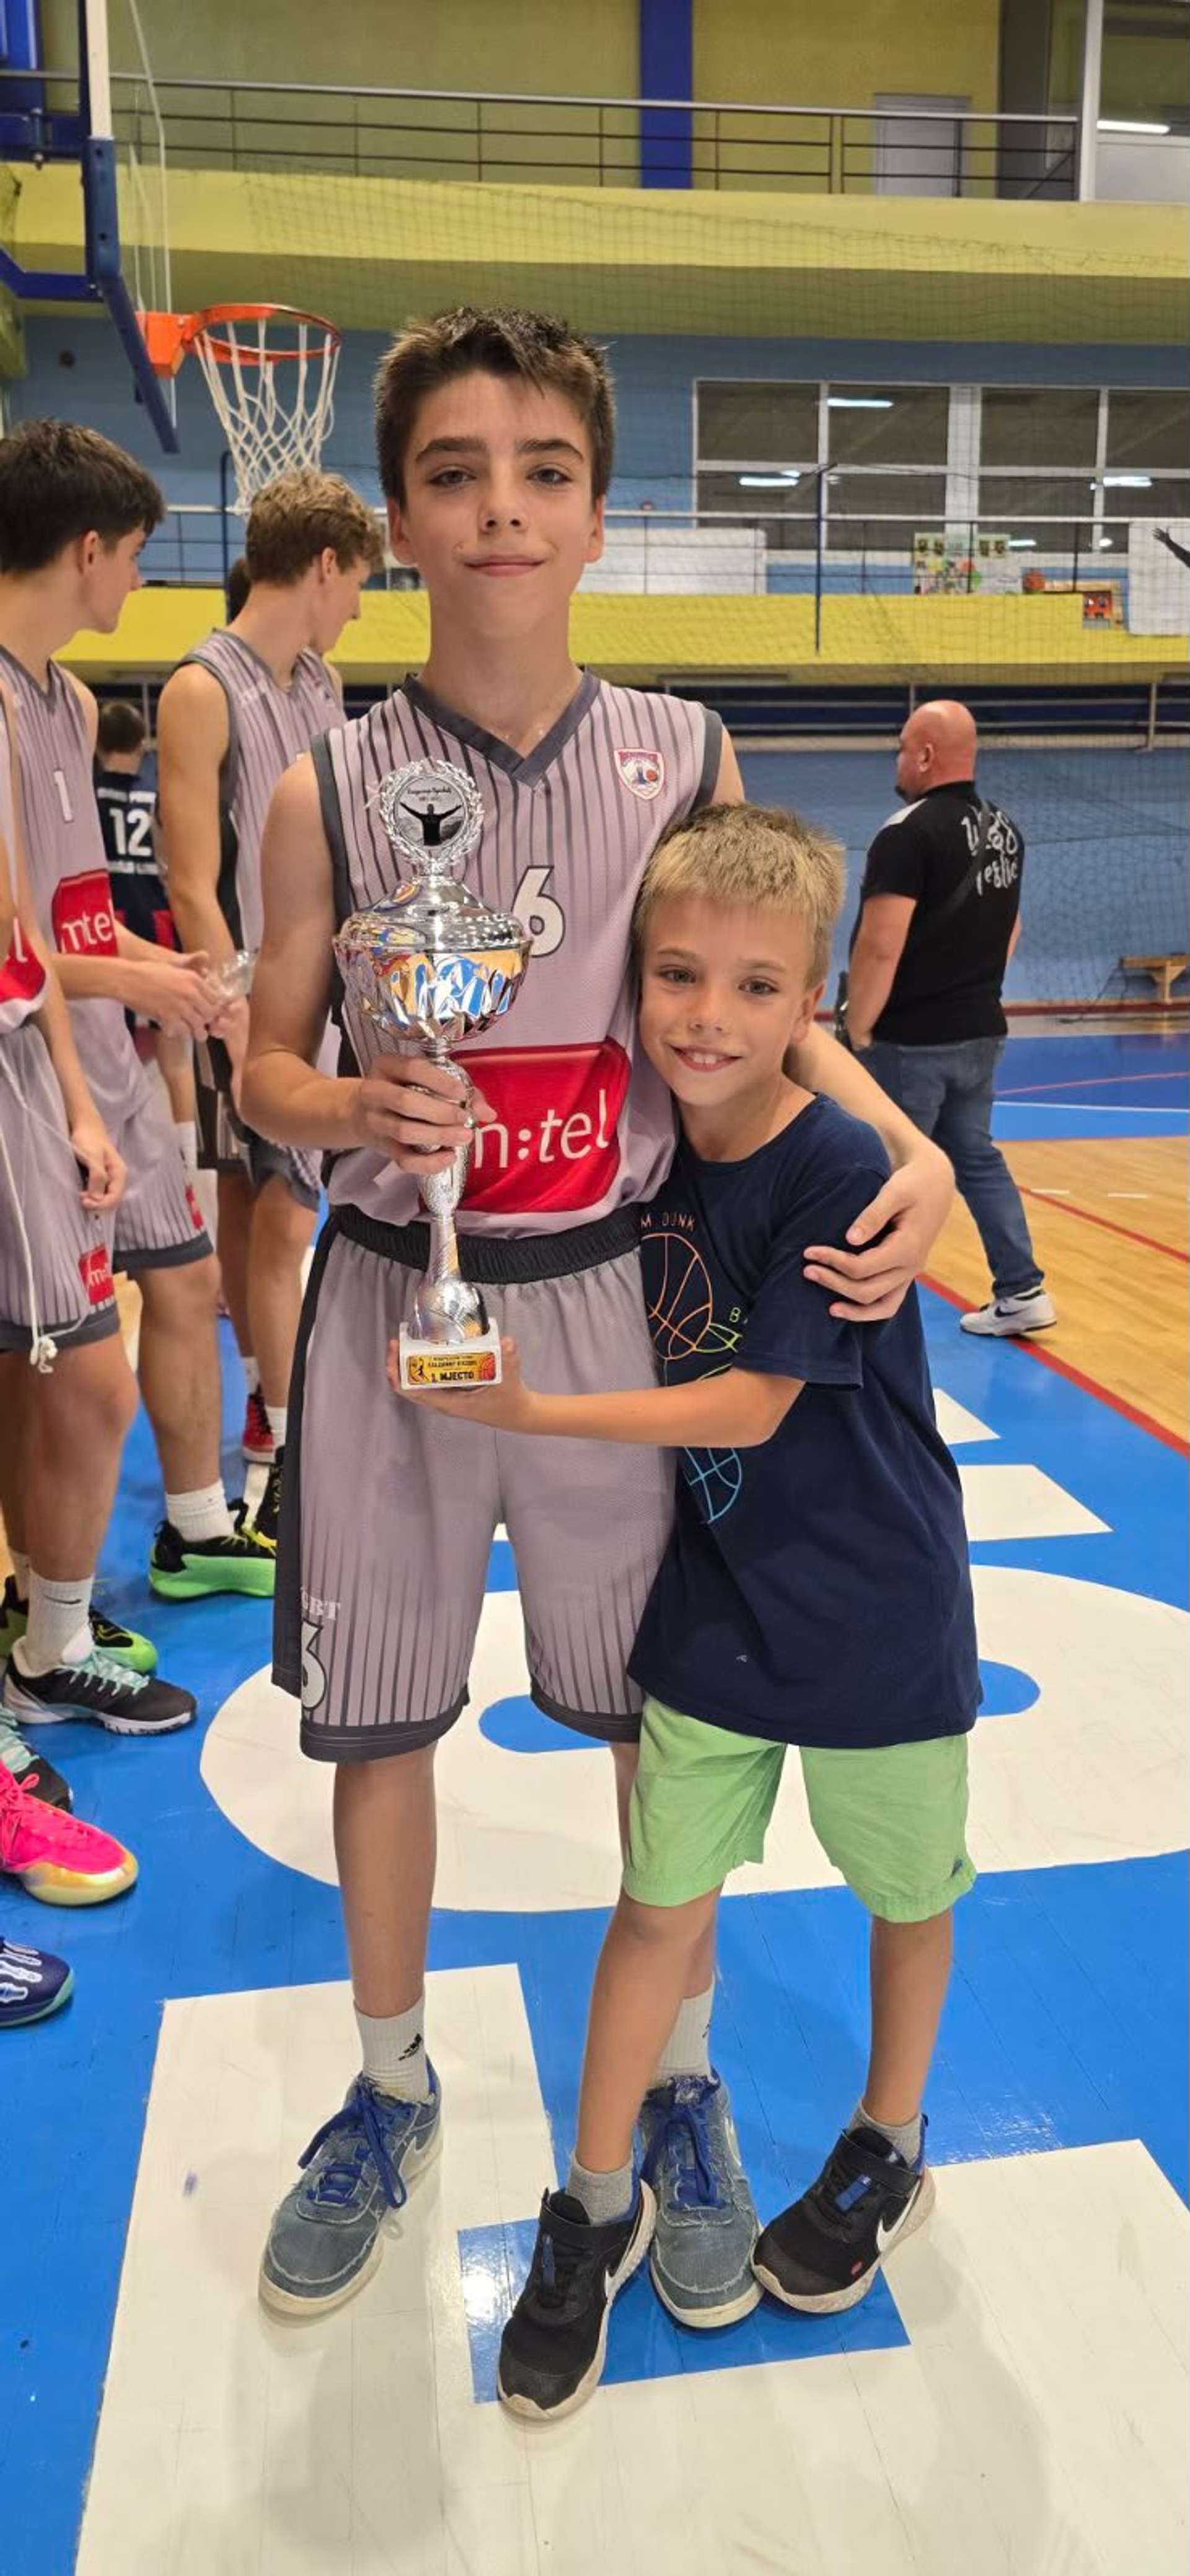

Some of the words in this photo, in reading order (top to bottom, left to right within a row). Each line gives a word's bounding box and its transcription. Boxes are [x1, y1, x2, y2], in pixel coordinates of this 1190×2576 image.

[53, 768, 73, 823] 1
[108, 806, 152, 858] 12
[510, 866, 566, 958] 6
[661, 1211, 695, 1232] DUNK
